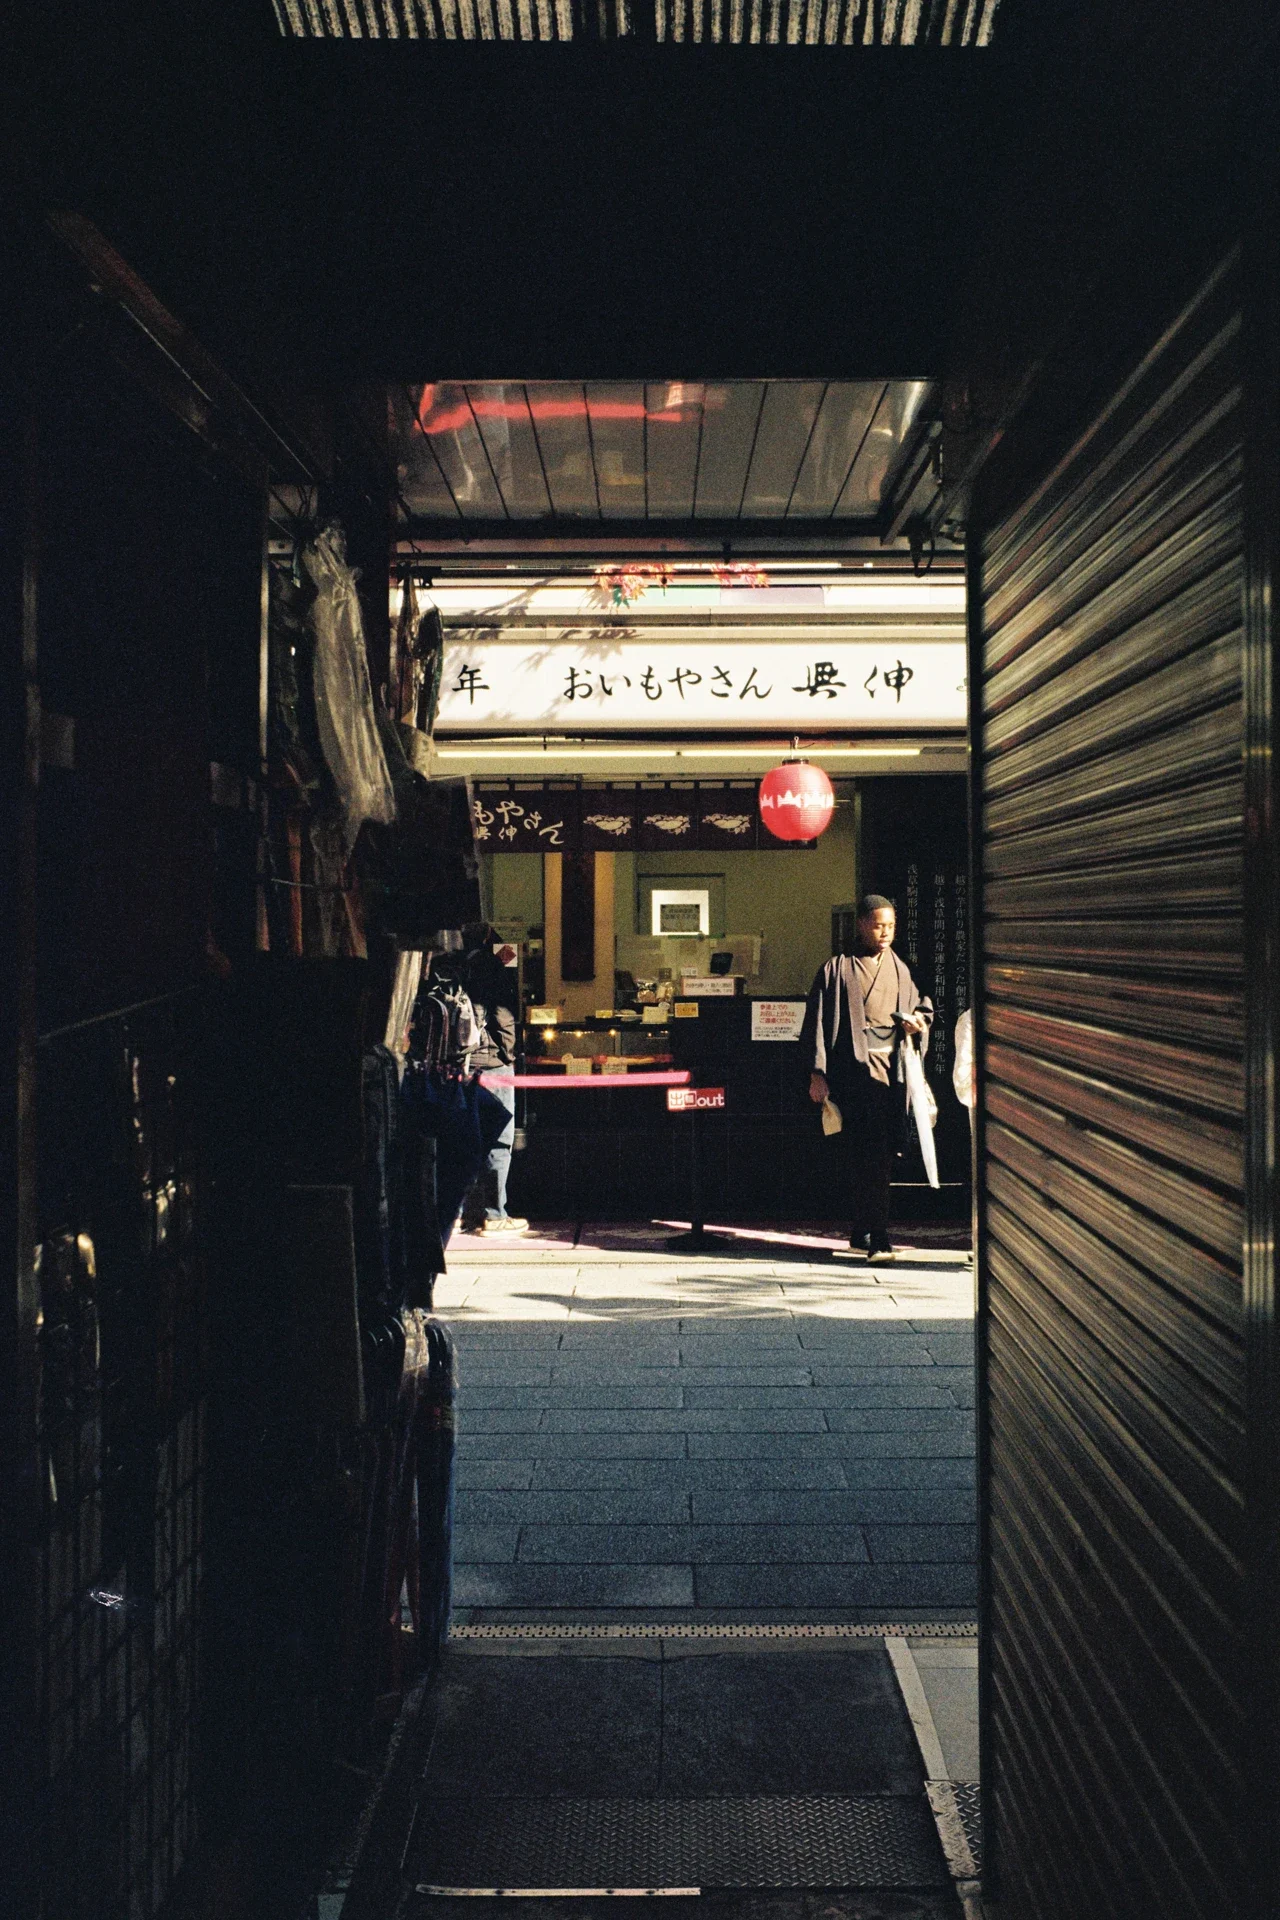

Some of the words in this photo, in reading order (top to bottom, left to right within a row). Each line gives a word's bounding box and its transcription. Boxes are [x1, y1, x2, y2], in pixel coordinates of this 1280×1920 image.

[451, 664, 490, 705] 年
[563, 665, 773, 701] おいもやさん
[955, 864, 967, 1015] 越の芋作り農家だった創業
[697, 1094, 725, 1107] out
